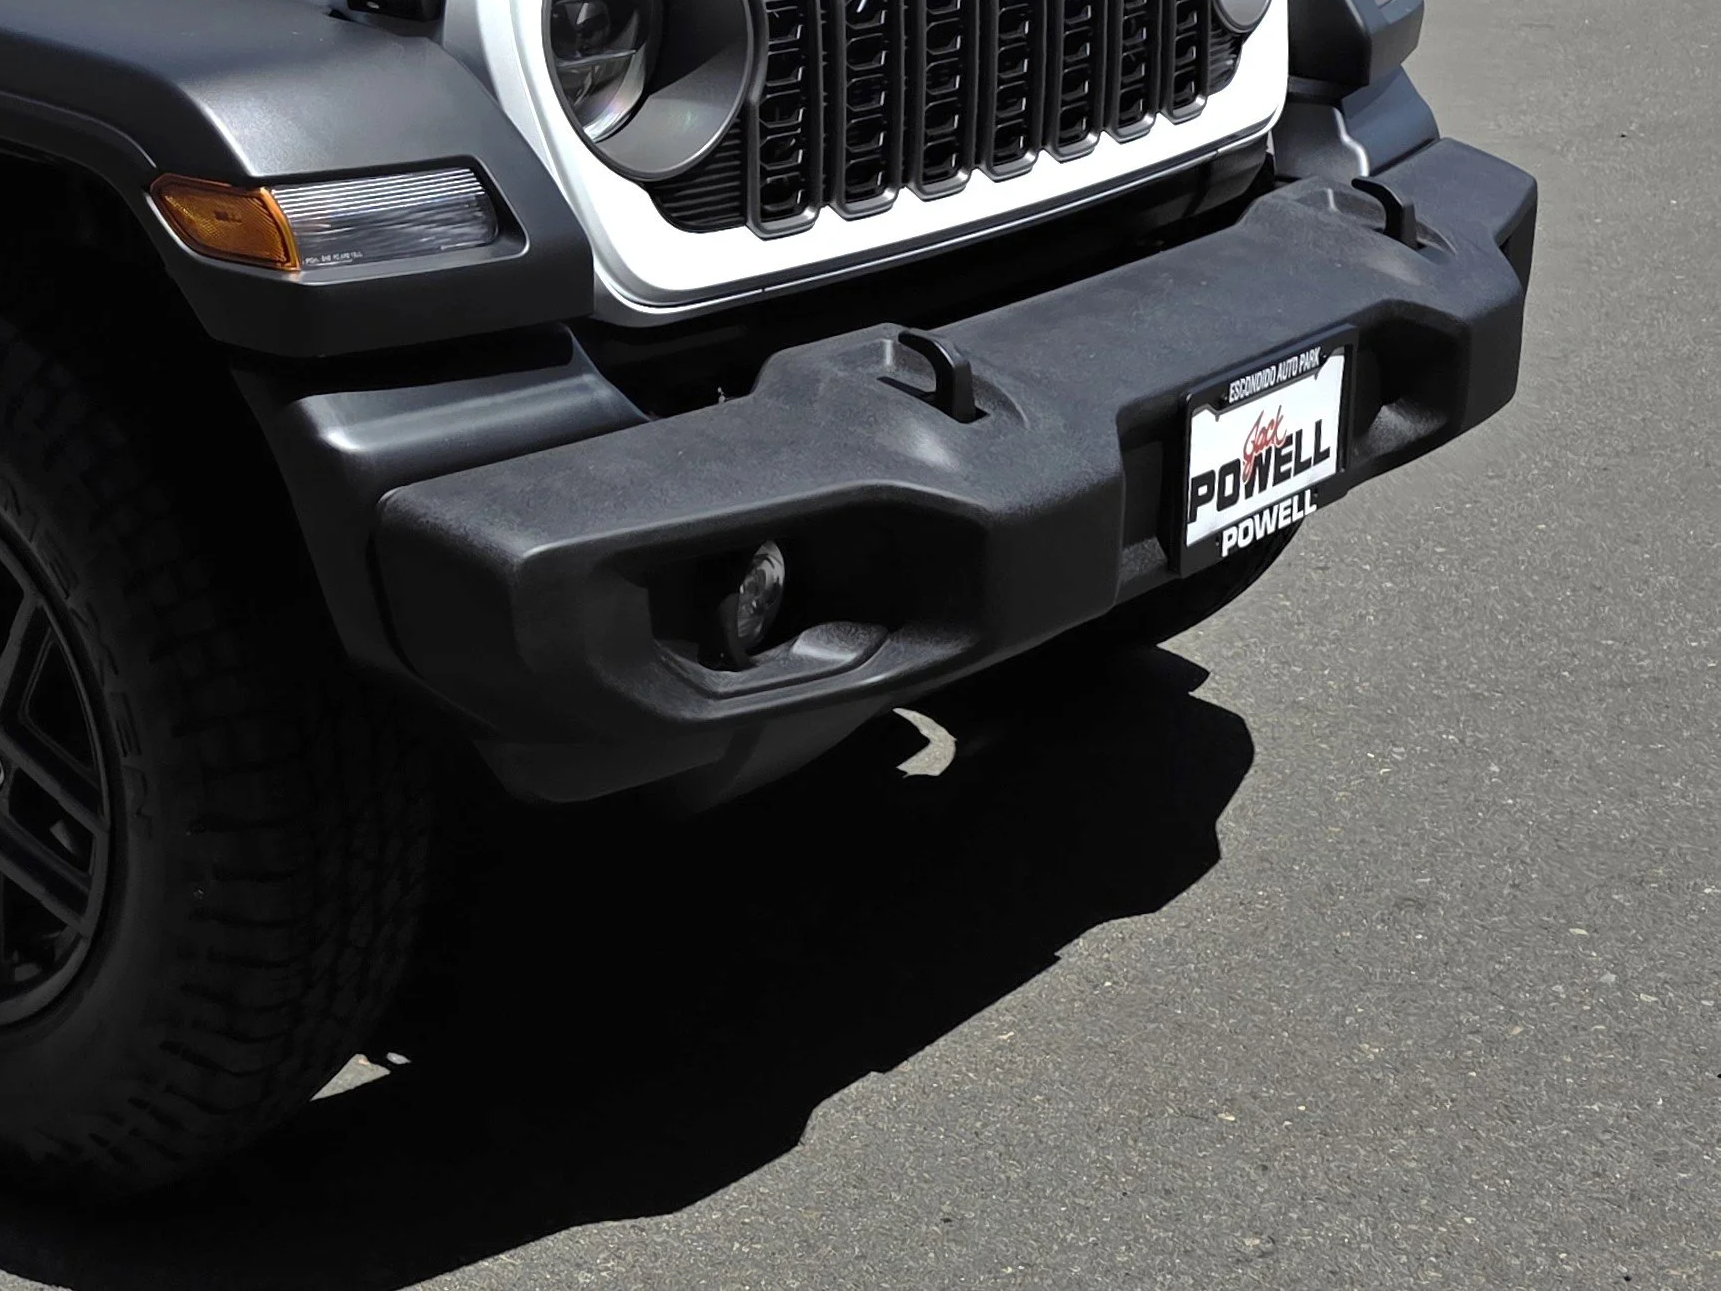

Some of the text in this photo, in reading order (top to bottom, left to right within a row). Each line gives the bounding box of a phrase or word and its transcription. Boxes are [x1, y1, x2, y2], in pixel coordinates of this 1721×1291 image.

[1228, 346, 1321, 404] ESCONDIDO AUTO PARK
[1187, 419, 1331, 524] POWELL
[1242, 405, 1287, 483] Jack
[1221, 490, 1318, 558] POWELL
